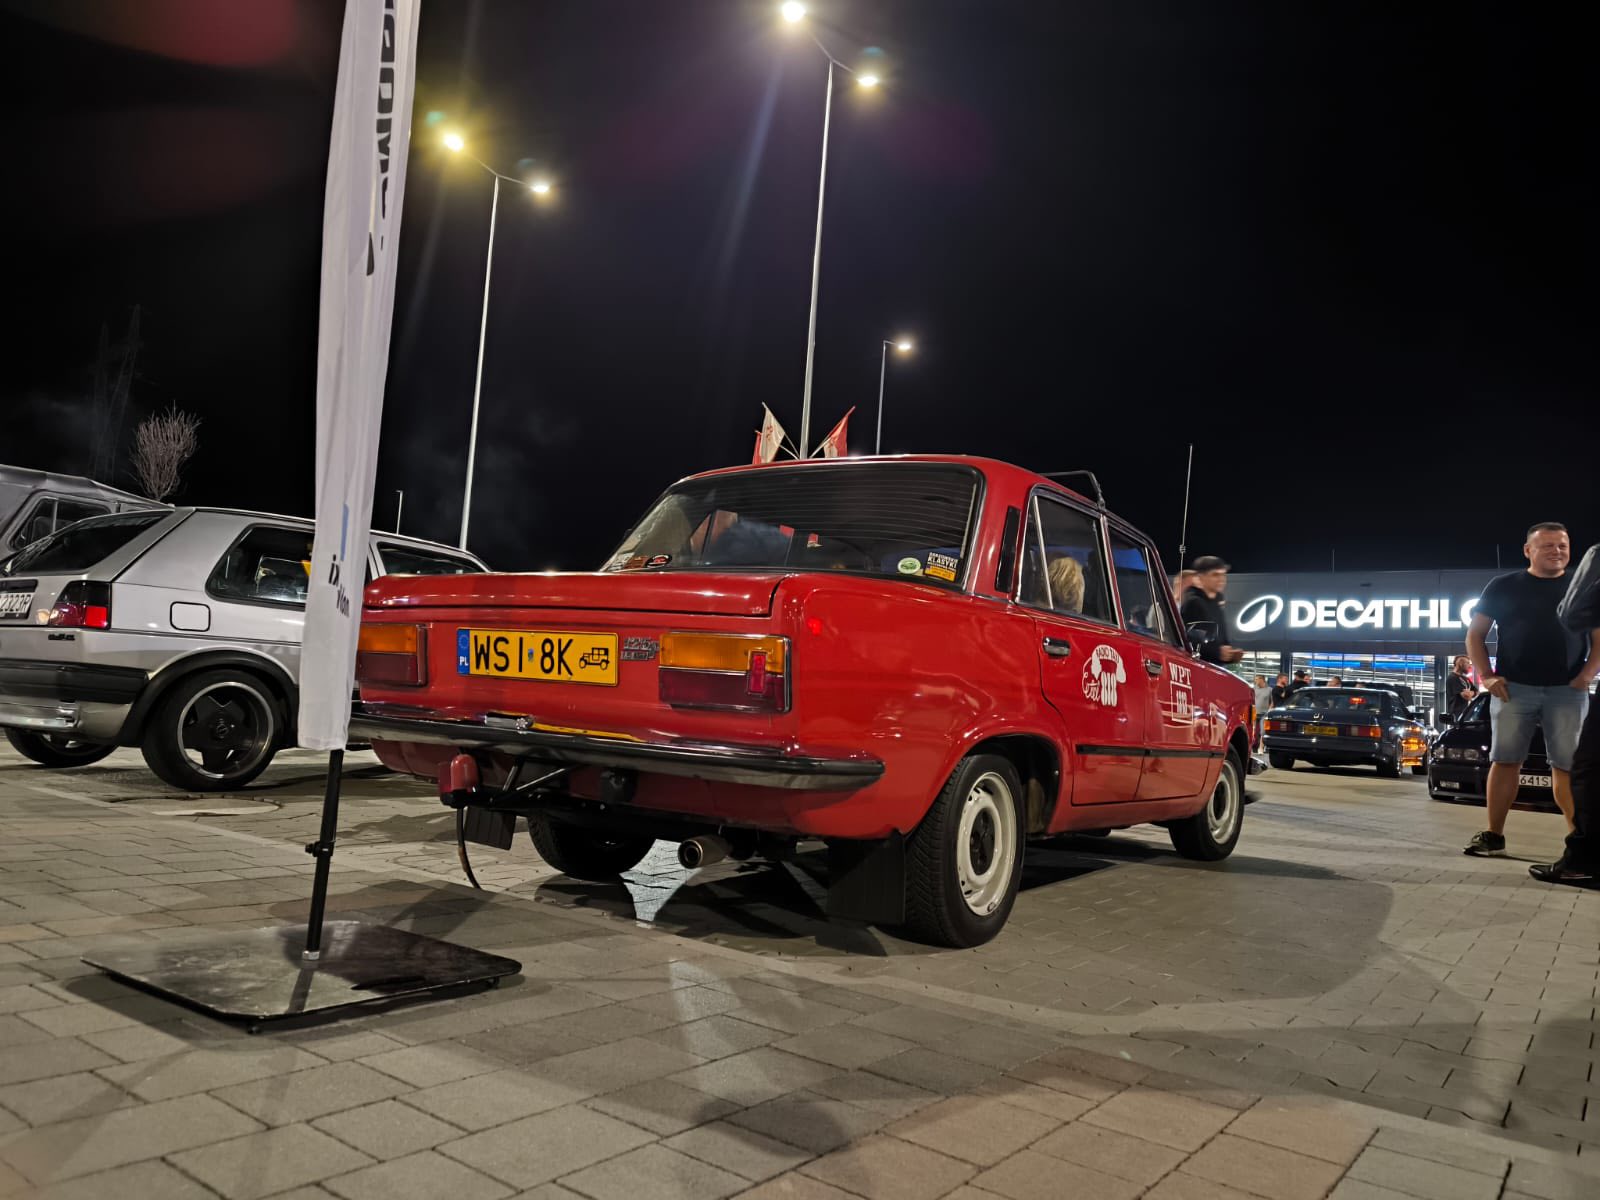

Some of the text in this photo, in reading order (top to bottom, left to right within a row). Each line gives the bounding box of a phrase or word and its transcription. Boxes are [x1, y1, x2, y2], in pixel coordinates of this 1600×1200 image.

[459, 656, 469, 666] PL
[474, 635, 573, 676] WSI 8K
[1169, 662, 1192, 686] WPT
